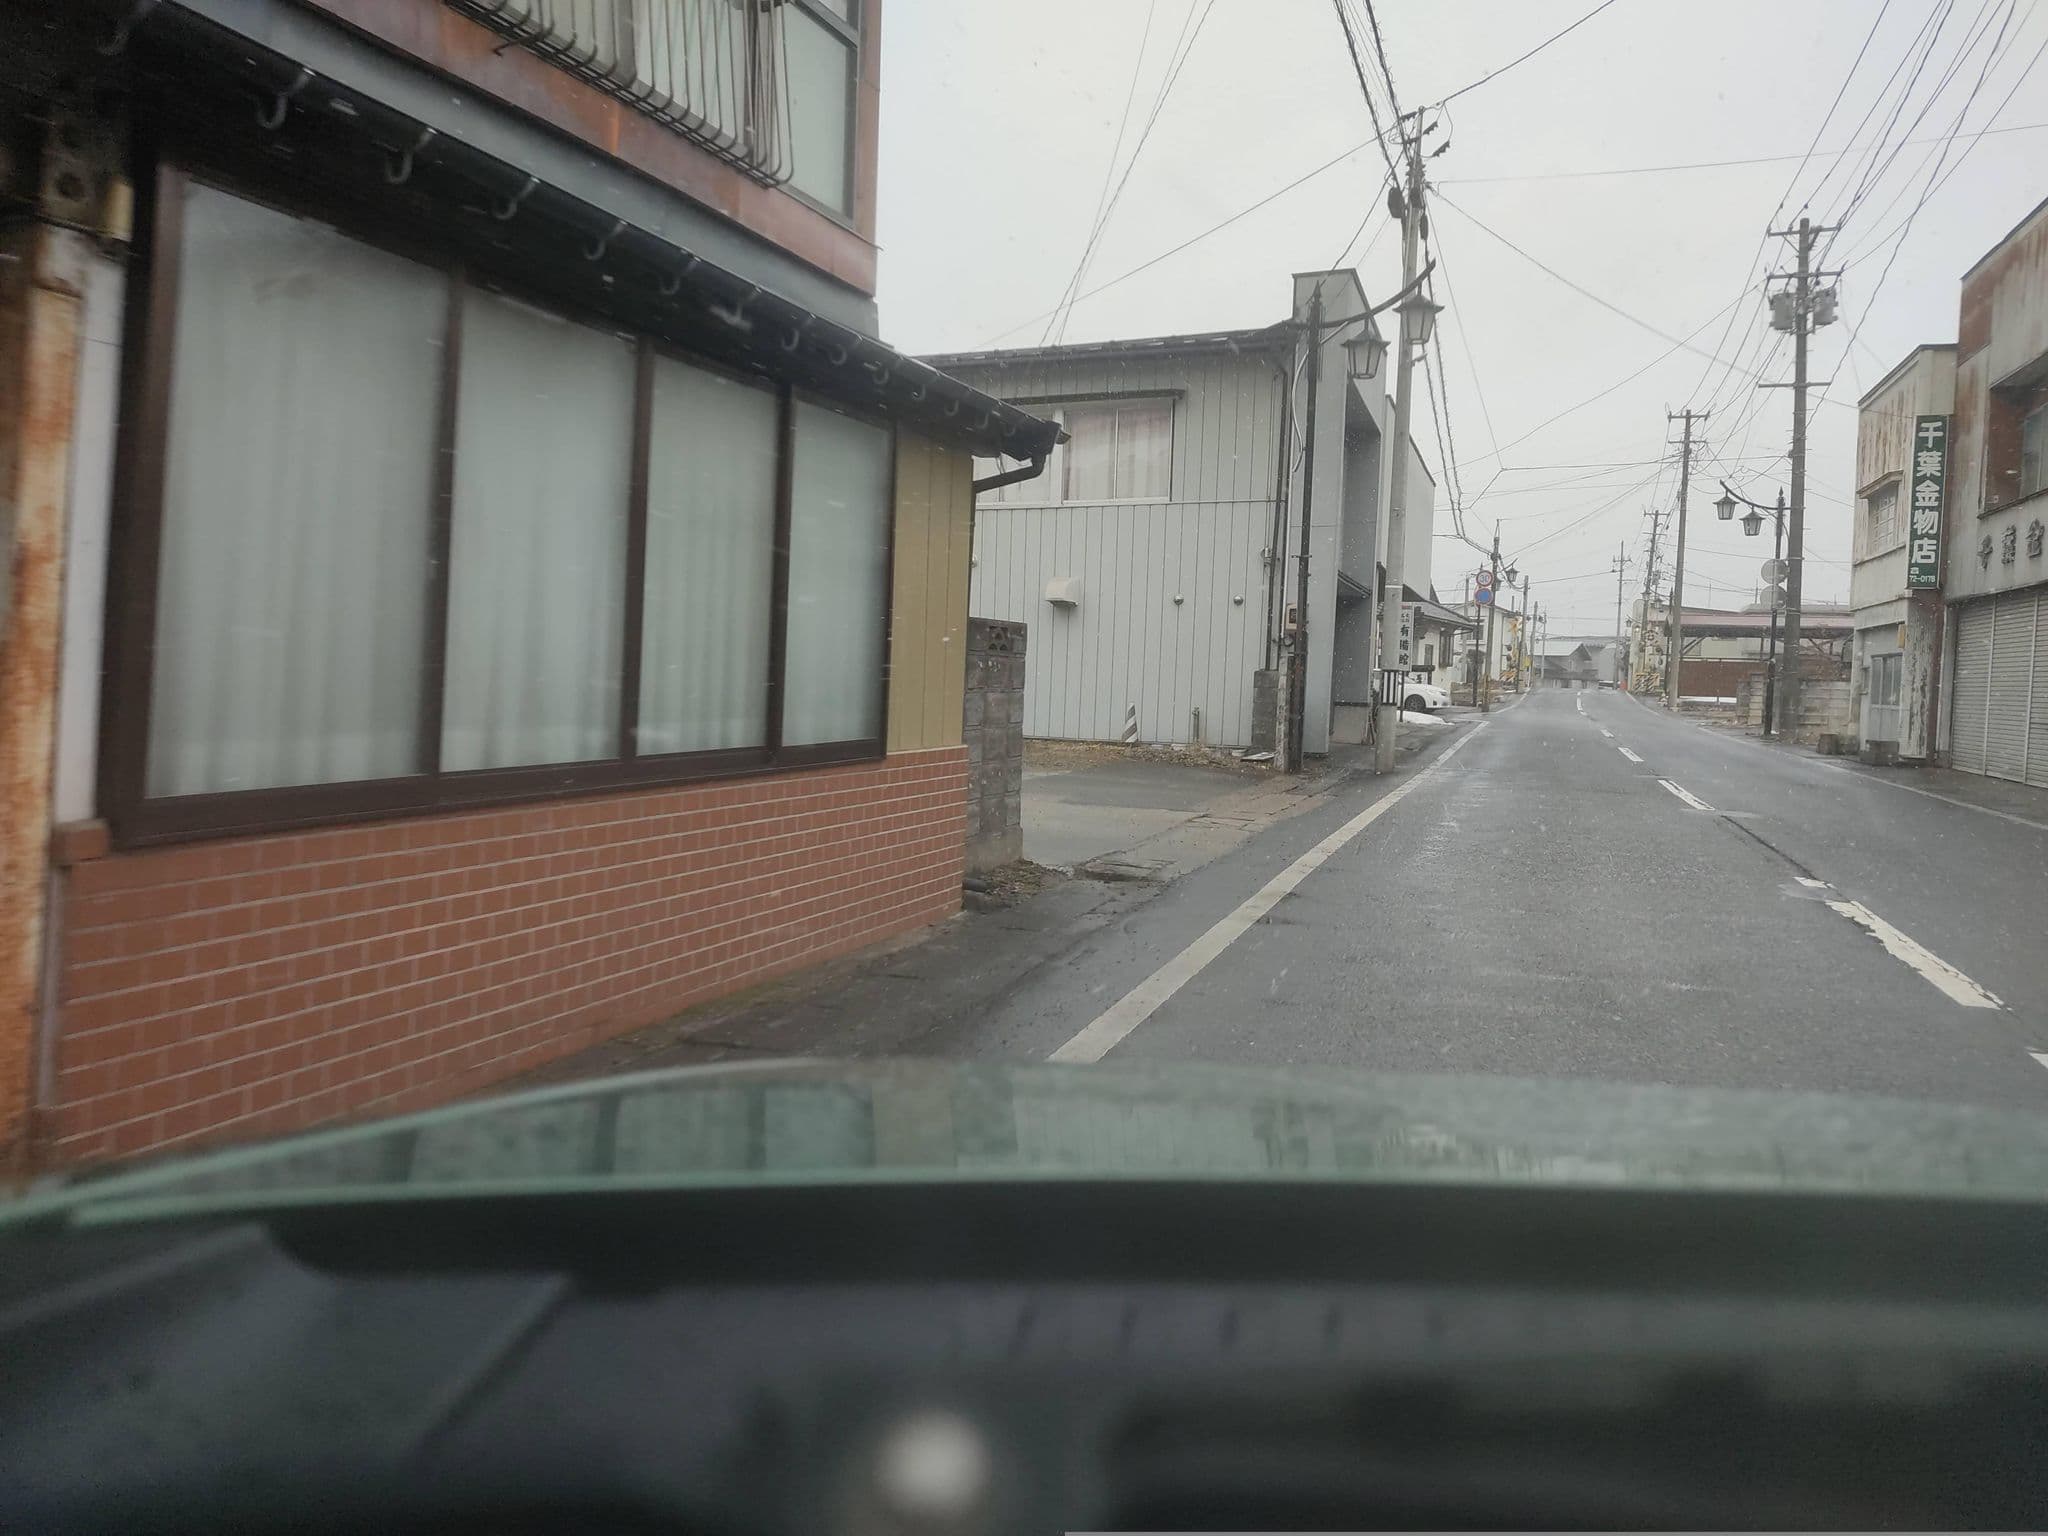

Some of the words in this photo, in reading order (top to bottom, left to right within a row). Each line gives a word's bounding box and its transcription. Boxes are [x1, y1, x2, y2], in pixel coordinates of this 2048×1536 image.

[1911, 421, 1944, 564] 千葉金物店
[1479, 574, 1490, 584] 30
